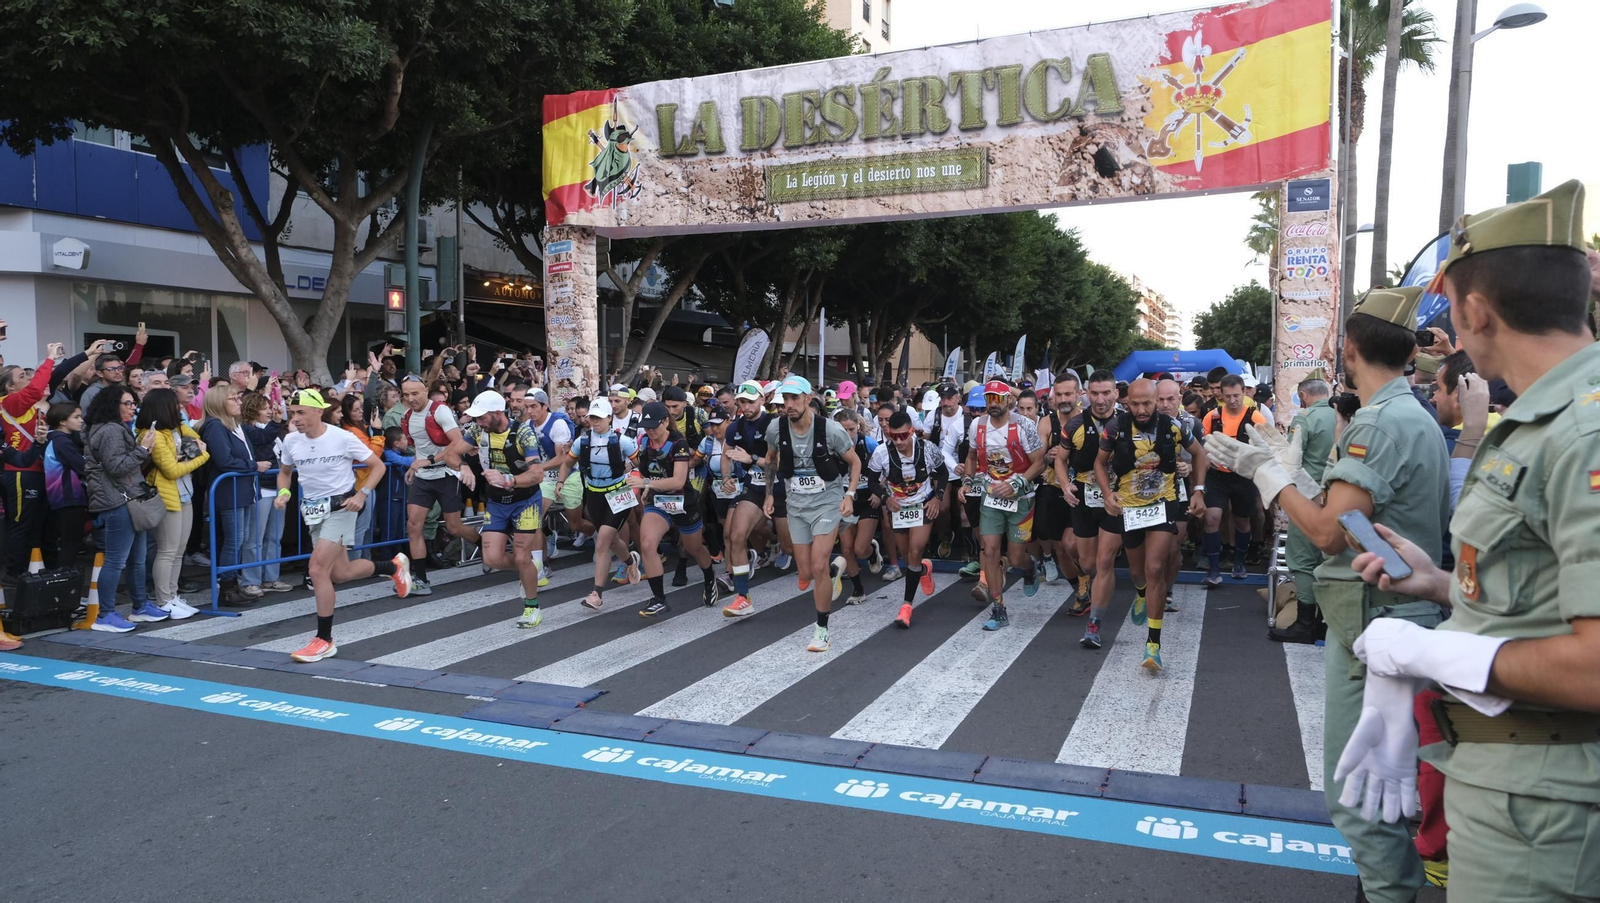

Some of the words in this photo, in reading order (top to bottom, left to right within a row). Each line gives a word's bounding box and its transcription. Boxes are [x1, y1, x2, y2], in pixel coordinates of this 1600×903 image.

[655, 101, 726, 157] LA
[740, 52, 1126, 150] DESÉRTICA
[786, 174, 797, 189] La
[802, 170, 836, 188] Legión
[841, 173, 848, 187] y
[854, 168, 863, 183] el
[868, 166, 911, 181] desierto
[917, 166, 936, 178] nos
[942, 164, 962, 176] une
[1287, 247, 1327, 255] GRUPO
[1287, 255, 1327, 266] RENTA
[1287, 266, 1327, 278] TODO
[551, 316, 571, 325] BBVA
[1284, 360, 1326, 369] primaflor
[799, 476, 816, 486] 805
[614, 492, 632, 504] 5410
[992, 497, 1014, 508] 5497
[305, 504, 325, 516] 2064
[900, 510, 919, 520] 5498
[1136, 506, 1160, 519] 5422
[89, 676, 185, 693] cajamar
[238, 699, 350, 720] cajamar
[421, 726, 549, 749] cajamar
[637, 757, 787, 783] cajamar
[699, 774, 730, 782] CAJA
[732, 778, 771, 788] RURAL
[899, 791, 1080, 821] cajamar
[980, 811, 1016, 819] CAJA
[1021, 816, 1069, 827] RURAL
